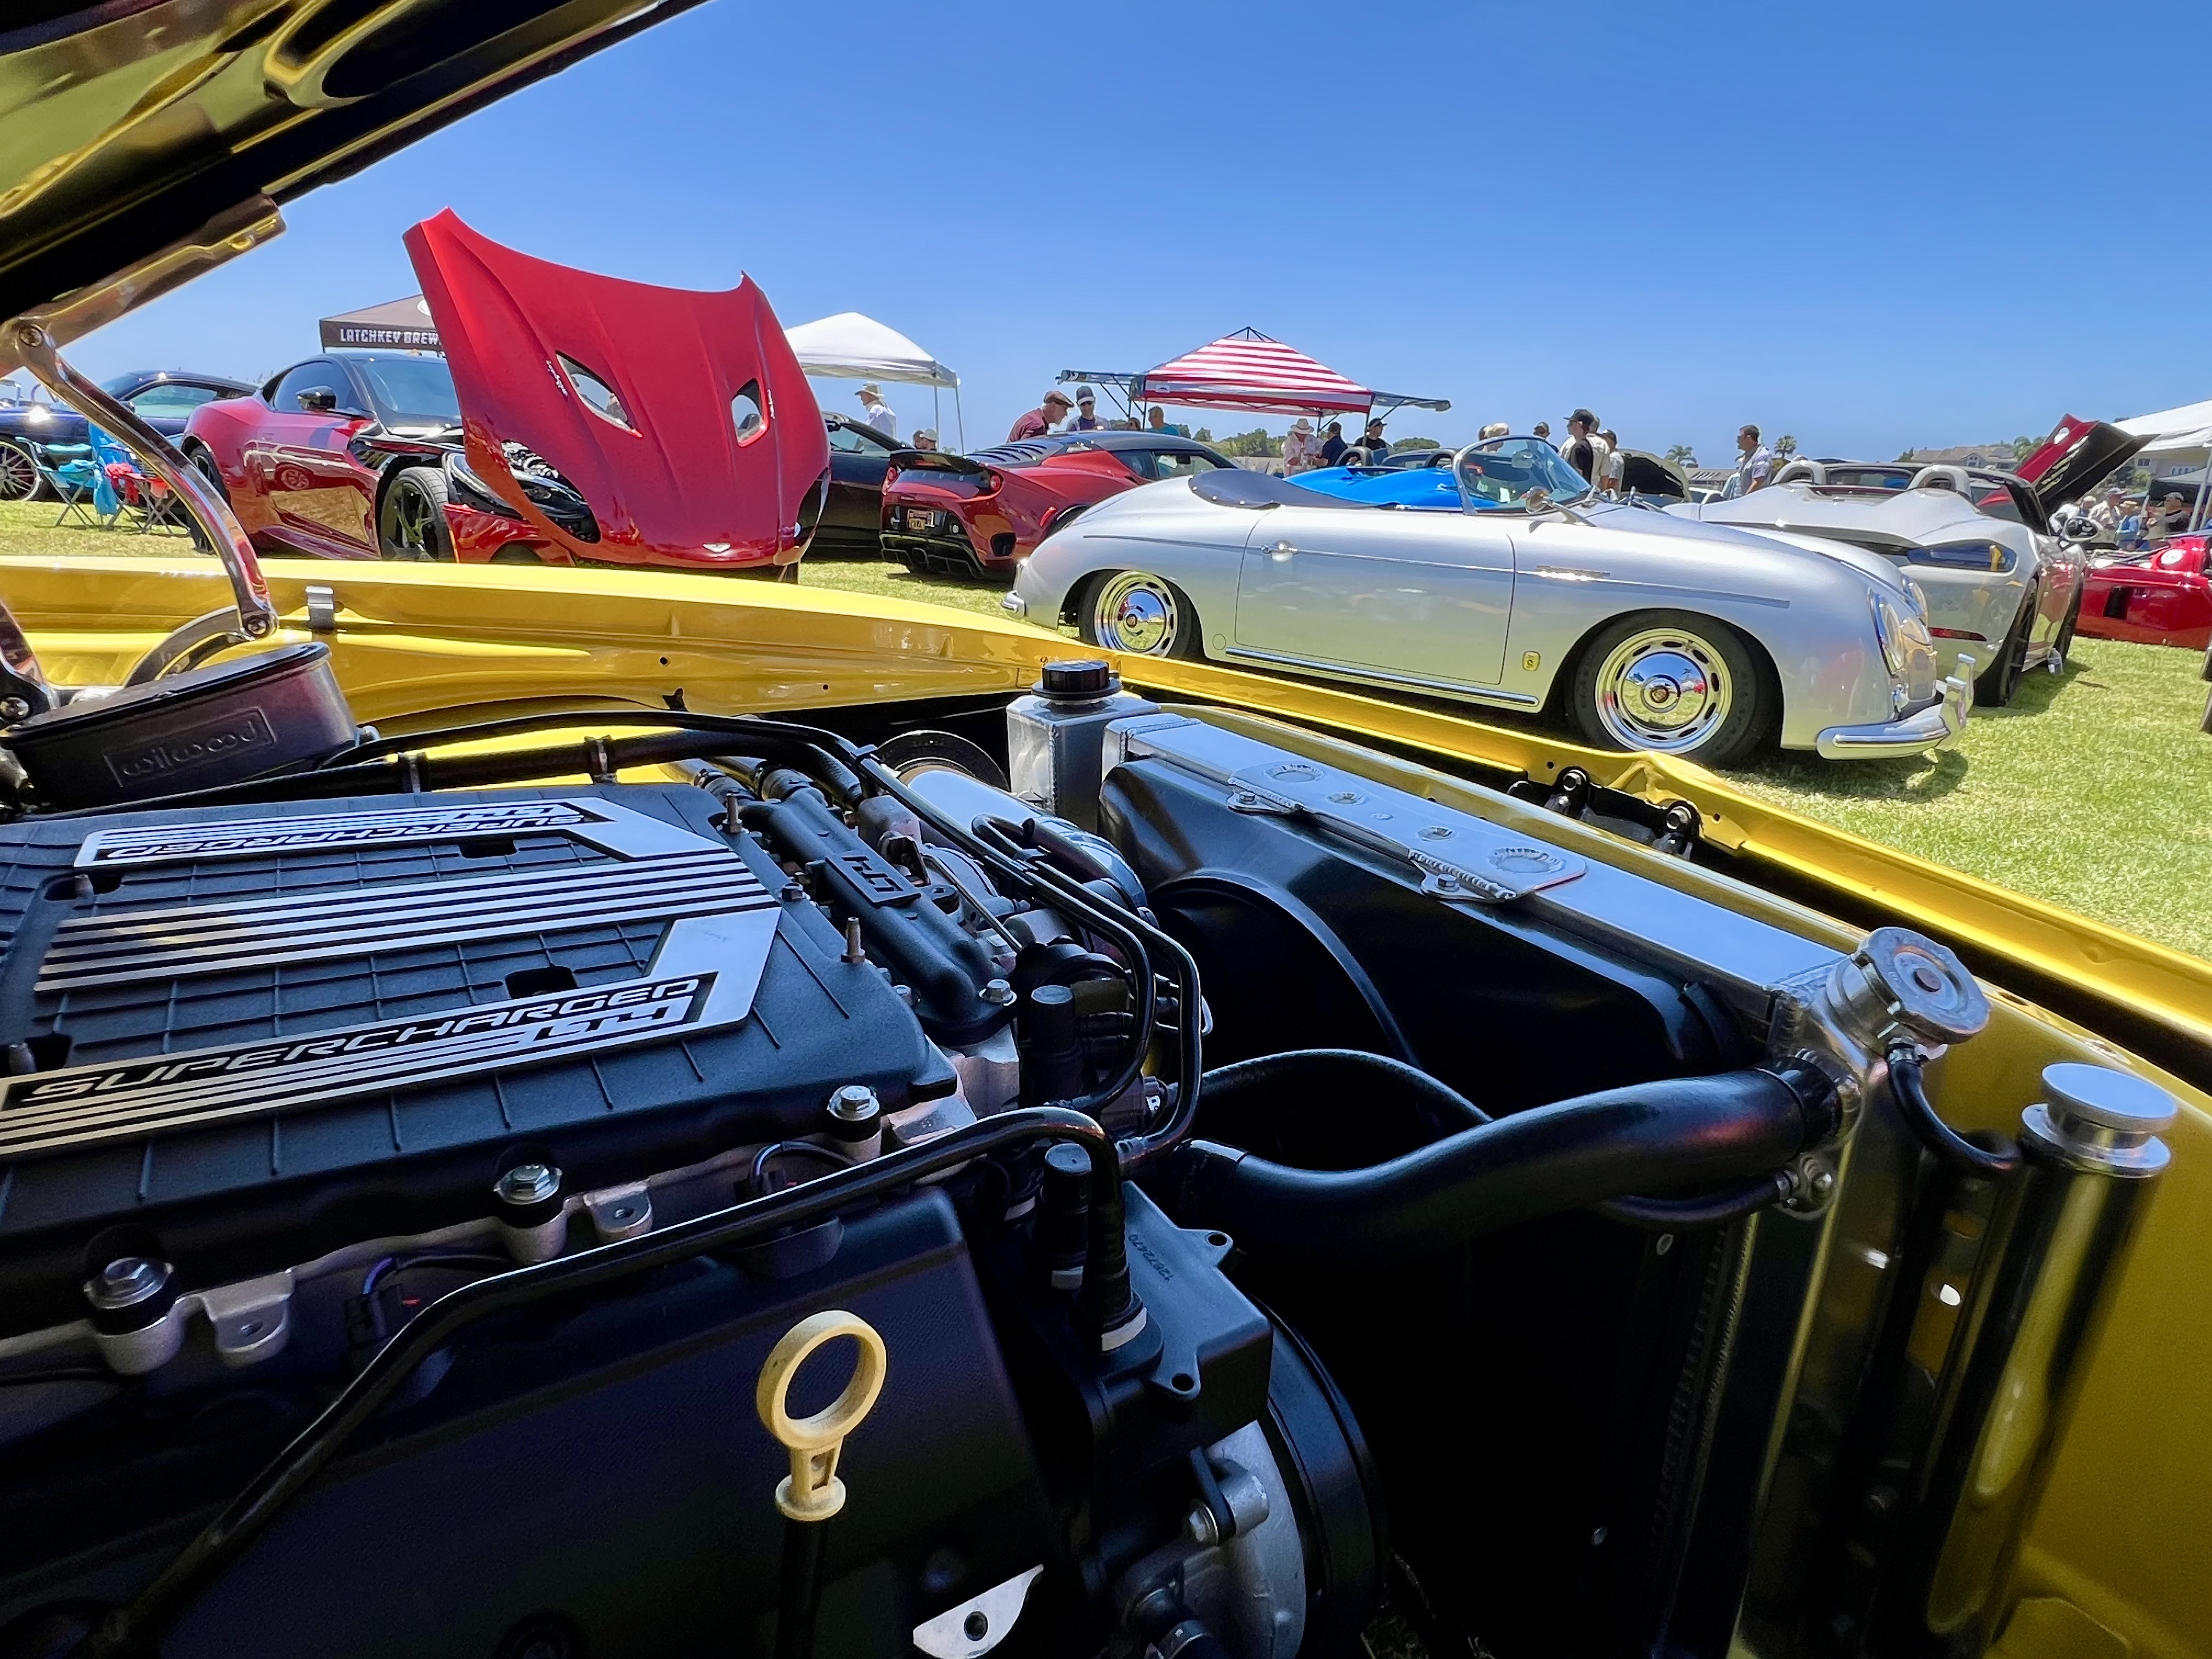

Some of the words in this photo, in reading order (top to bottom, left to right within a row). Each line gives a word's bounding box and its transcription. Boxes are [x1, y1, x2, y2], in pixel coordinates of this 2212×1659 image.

[340, 328, 400, 343] LATCHKEY
[404, 331, 442, 346] BREW
[122, 720, 257, 776] wilwood
[107, 815, 585, 859] SUPERCHARGED
[841, 856, 904, 893] LT4
[20, 979, 699, 1103] SUPERCHARGED
[533, 1005, 671, 1042] LT4
